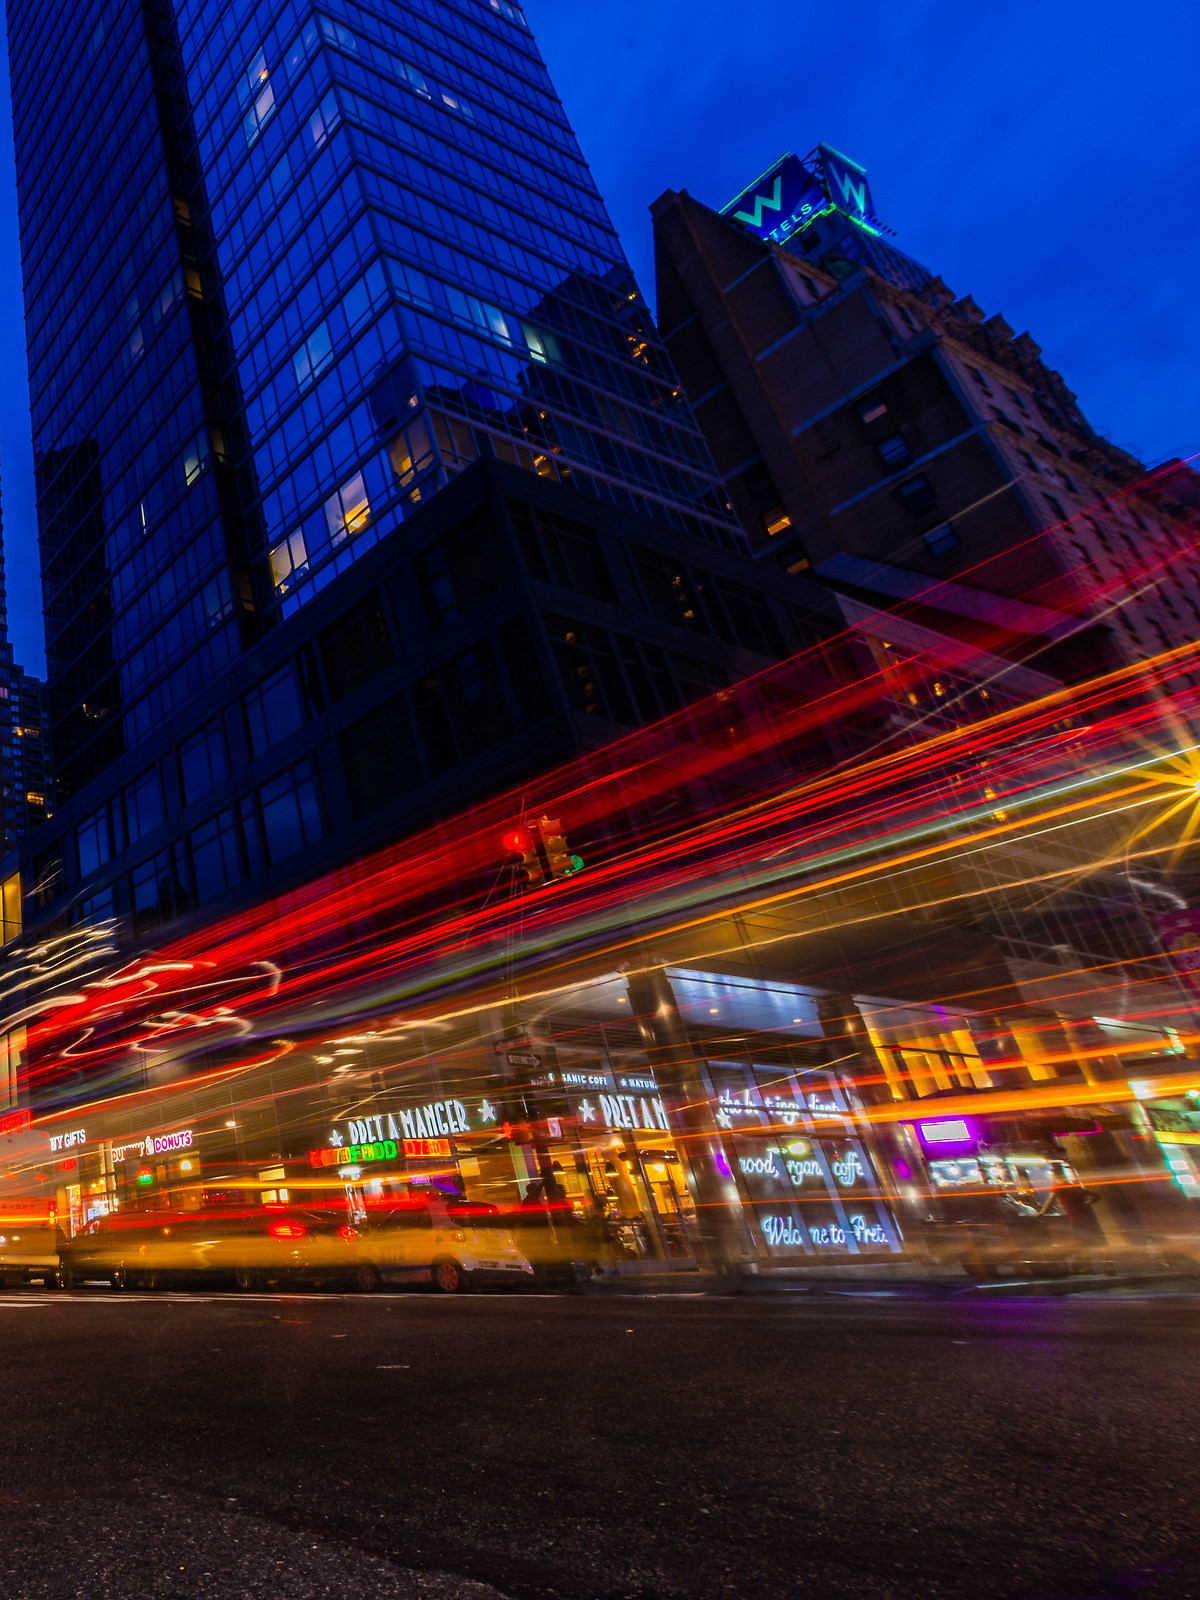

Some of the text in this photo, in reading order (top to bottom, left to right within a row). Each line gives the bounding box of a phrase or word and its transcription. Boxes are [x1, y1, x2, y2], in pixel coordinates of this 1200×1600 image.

[733, 175, 782, 228] W
[827, 160, 866, 216] W
[763, 202, 813, 241] TELS
[348, 1100, 471, 1144] PRET A MANGER
[598, 1094, 640, 1129] PRET
[640, 1097, 655, 1129] A
[64, 1128, 87, 1148] GIFTS
[154, 1130, 193, 1152] DONUTS
[349, 1139, 398, 1163] FOOD
[829, 1223, 846, 1244] to
